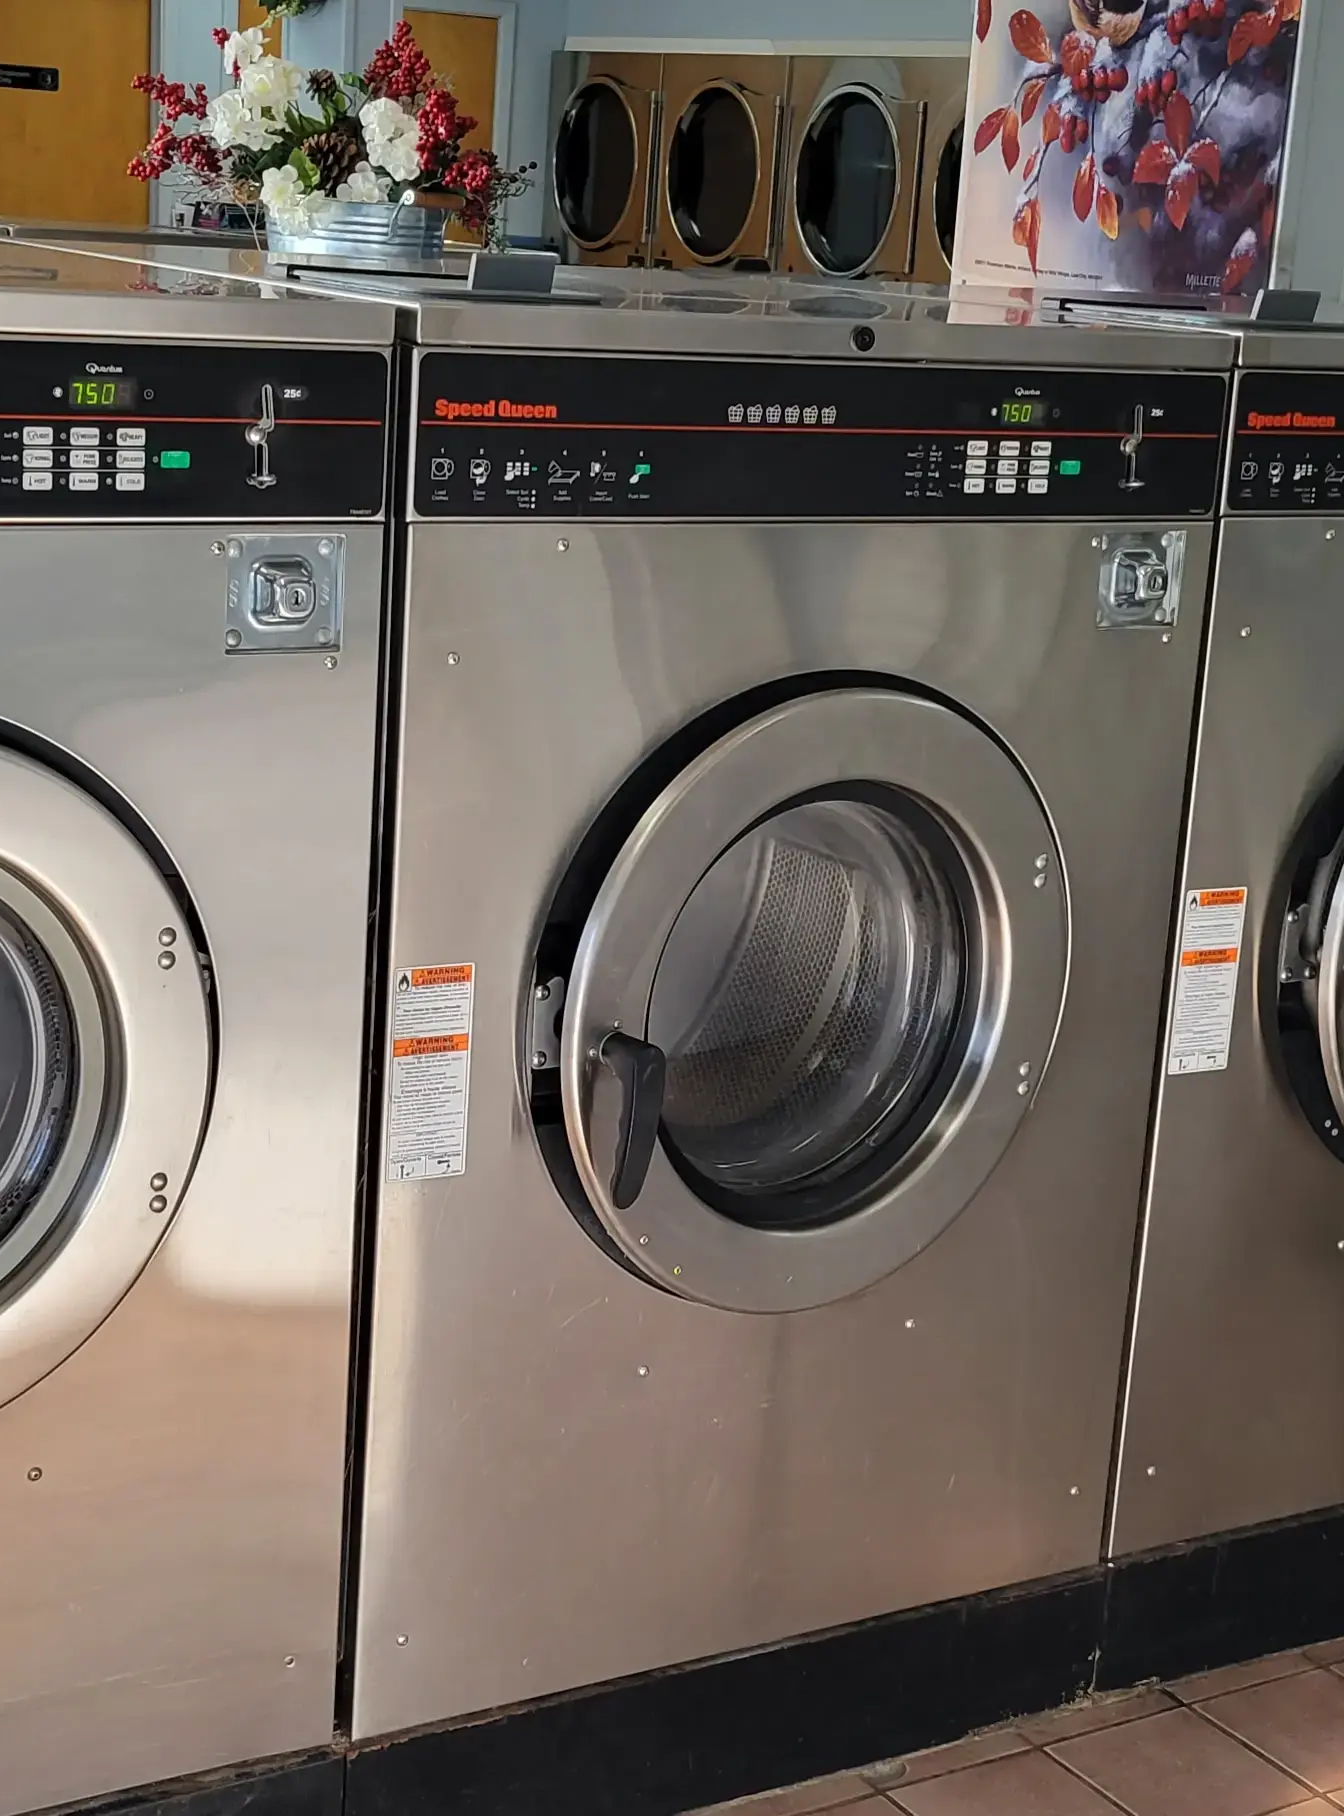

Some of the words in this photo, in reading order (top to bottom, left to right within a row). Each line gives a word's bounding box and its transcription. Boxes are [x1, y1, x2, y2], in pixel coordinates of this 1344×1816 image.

[72, 383, 116, 404] 750
[435, 399, 495, 420] Speed
[498, 400, 557, 418] Queen
[1003, 404, 1032, 422] 750
[1247, 412, 1291, 429] Speed
[1293, 412, 1336, 428] Queen
[426, 966, 465, 976] WARNING
[415, 1036, 454, 1046] WARNING
